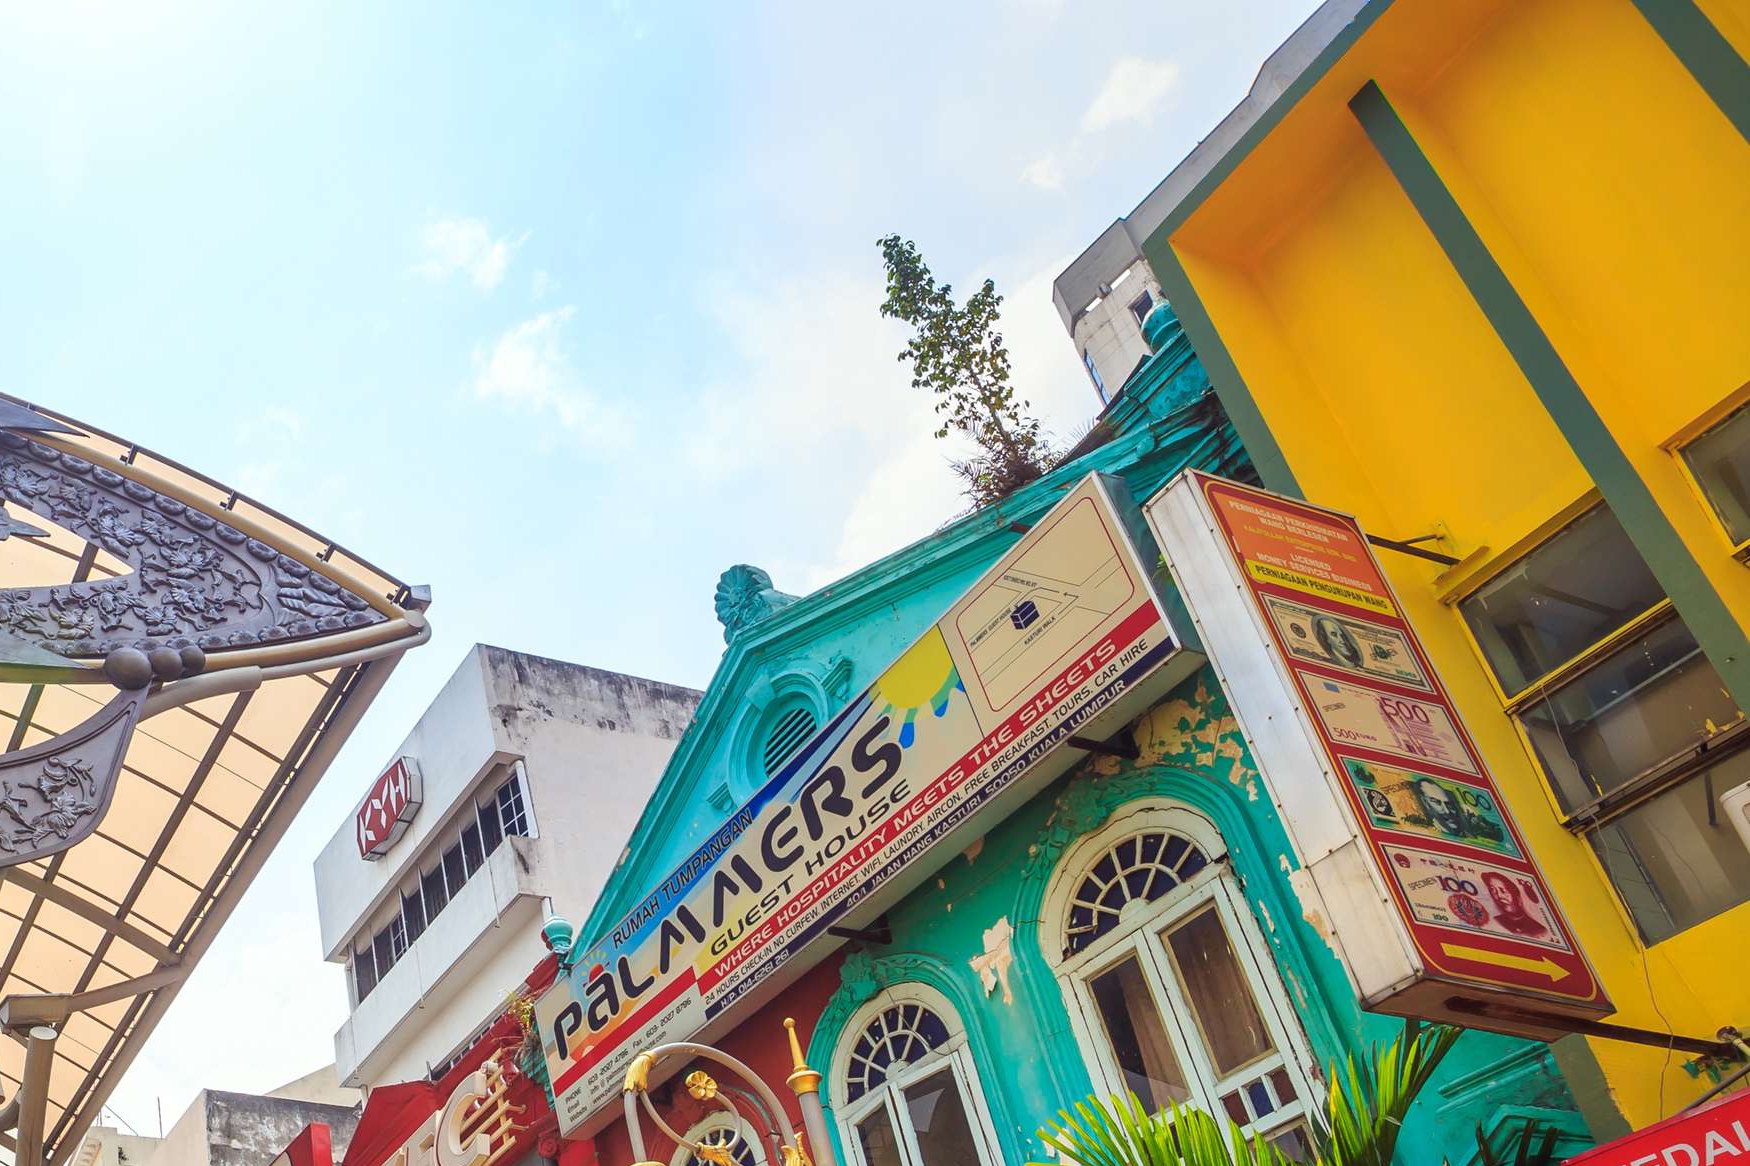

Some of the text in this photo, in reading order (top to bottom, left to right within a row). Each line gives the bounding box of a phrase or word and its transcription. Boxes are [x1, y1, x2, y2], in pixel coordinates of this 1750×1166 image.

[612, 805, 753, 949] RUMAH TUMPANGAN
[708, 776, 911, 959] GUEST HOUSE
[714, 636, 1118, 980] WHERE HOSPITALITY MEETS THE SHEETS
[715, 970, 740, 996] HOURS
[740, 943, 773, 976] CHECK-IN
[772, 933, 785, 950] NO
[963, 767, 990, 795] FREE
[1093, 661, 1120, 689] CAR
[1119, 637, 1149, 668] HIRE
[871, 857, 902, 889] JALAN
[903, 832, 934, 863] HANG
[933, 794, 982, 839] KASTURI
[984, 758, 1027, 798] 50050
[1028, 724, 1069, 764] KUALA
[1069, 678, 1126, 730] LUMPUR
